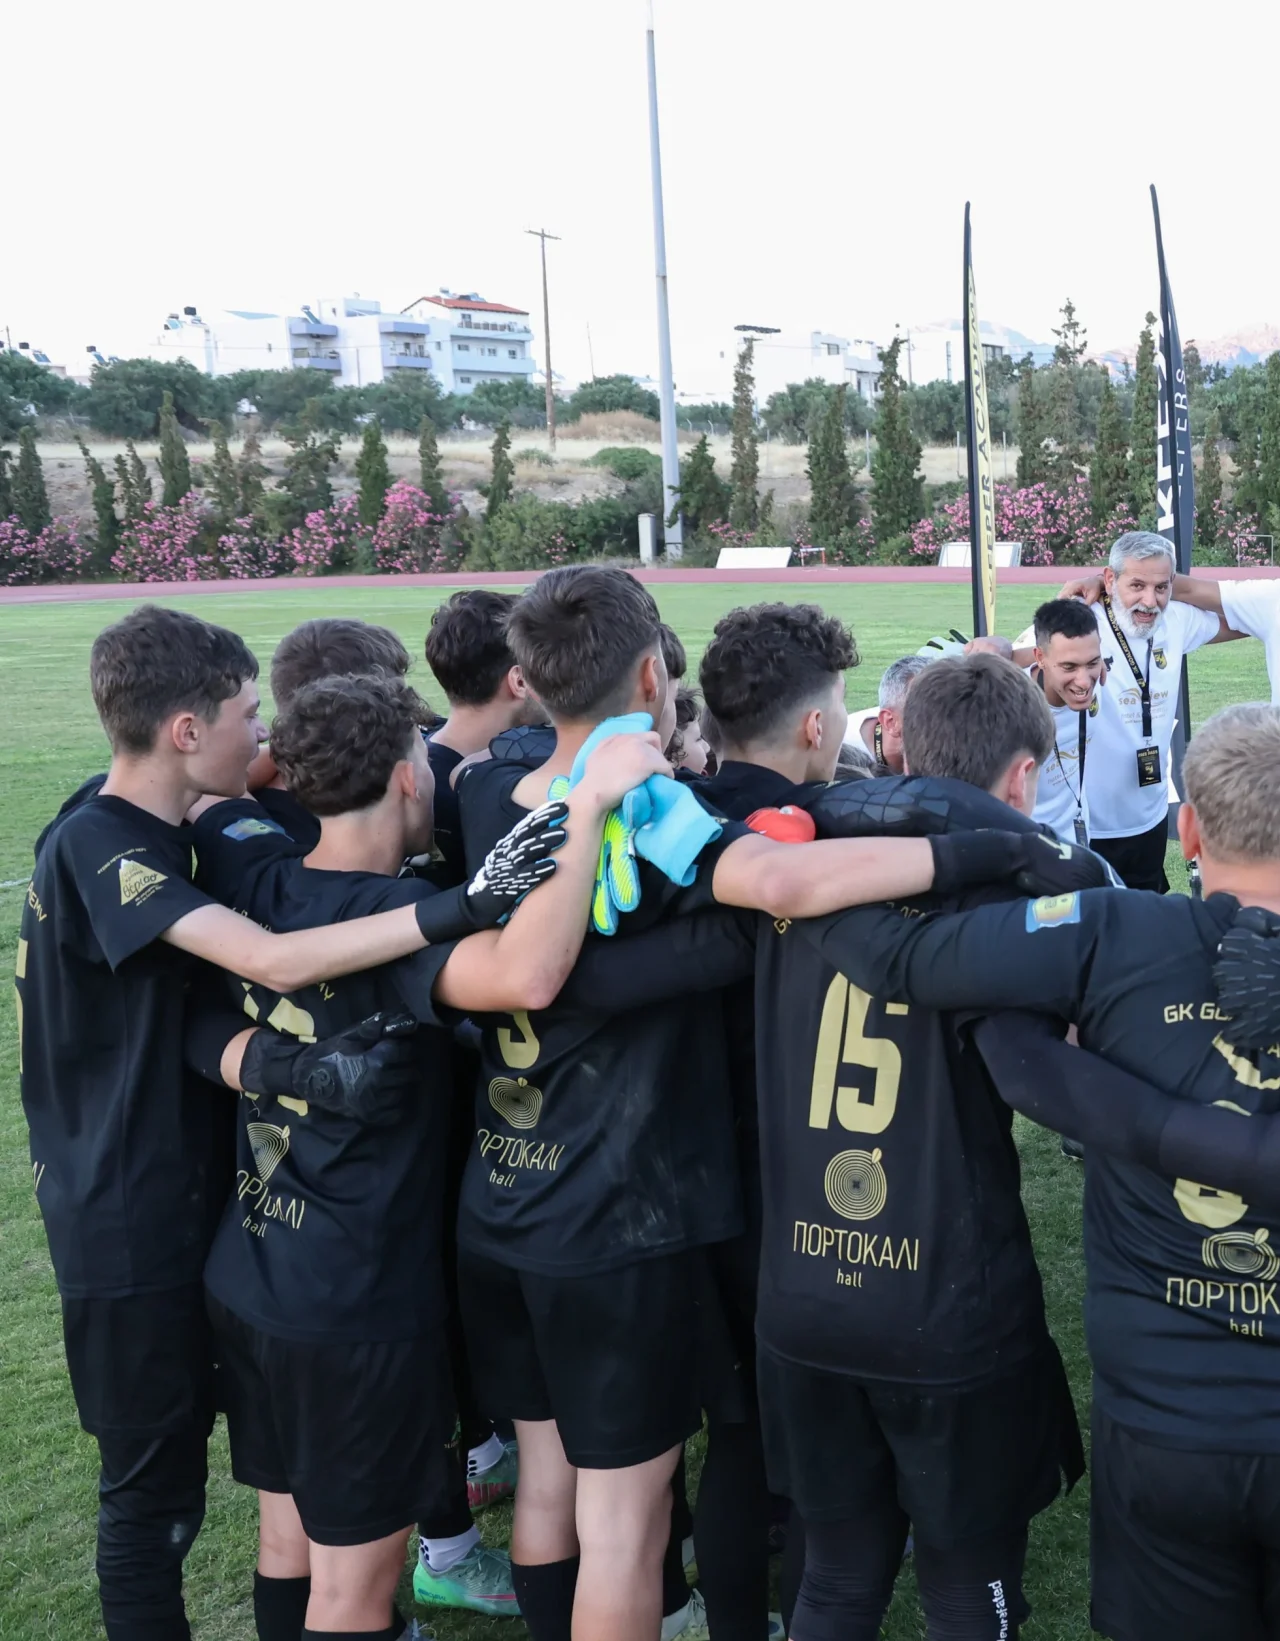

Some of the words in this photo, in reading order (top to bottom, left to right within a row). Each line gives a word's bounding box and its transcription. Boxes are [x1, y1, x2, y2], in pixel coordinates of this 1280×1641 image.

[1150, 689, 1169, 700] iew
[1164, 1003, 1194, 1024] GK
[809, 971, 909, 1134] 15
[489, 1168, 517, 1187] hall
[242, 1214, 268, 1238] hall
[836, 1268, 863, 1288] hall
[1229, 1318, 1264, 1337] hall
